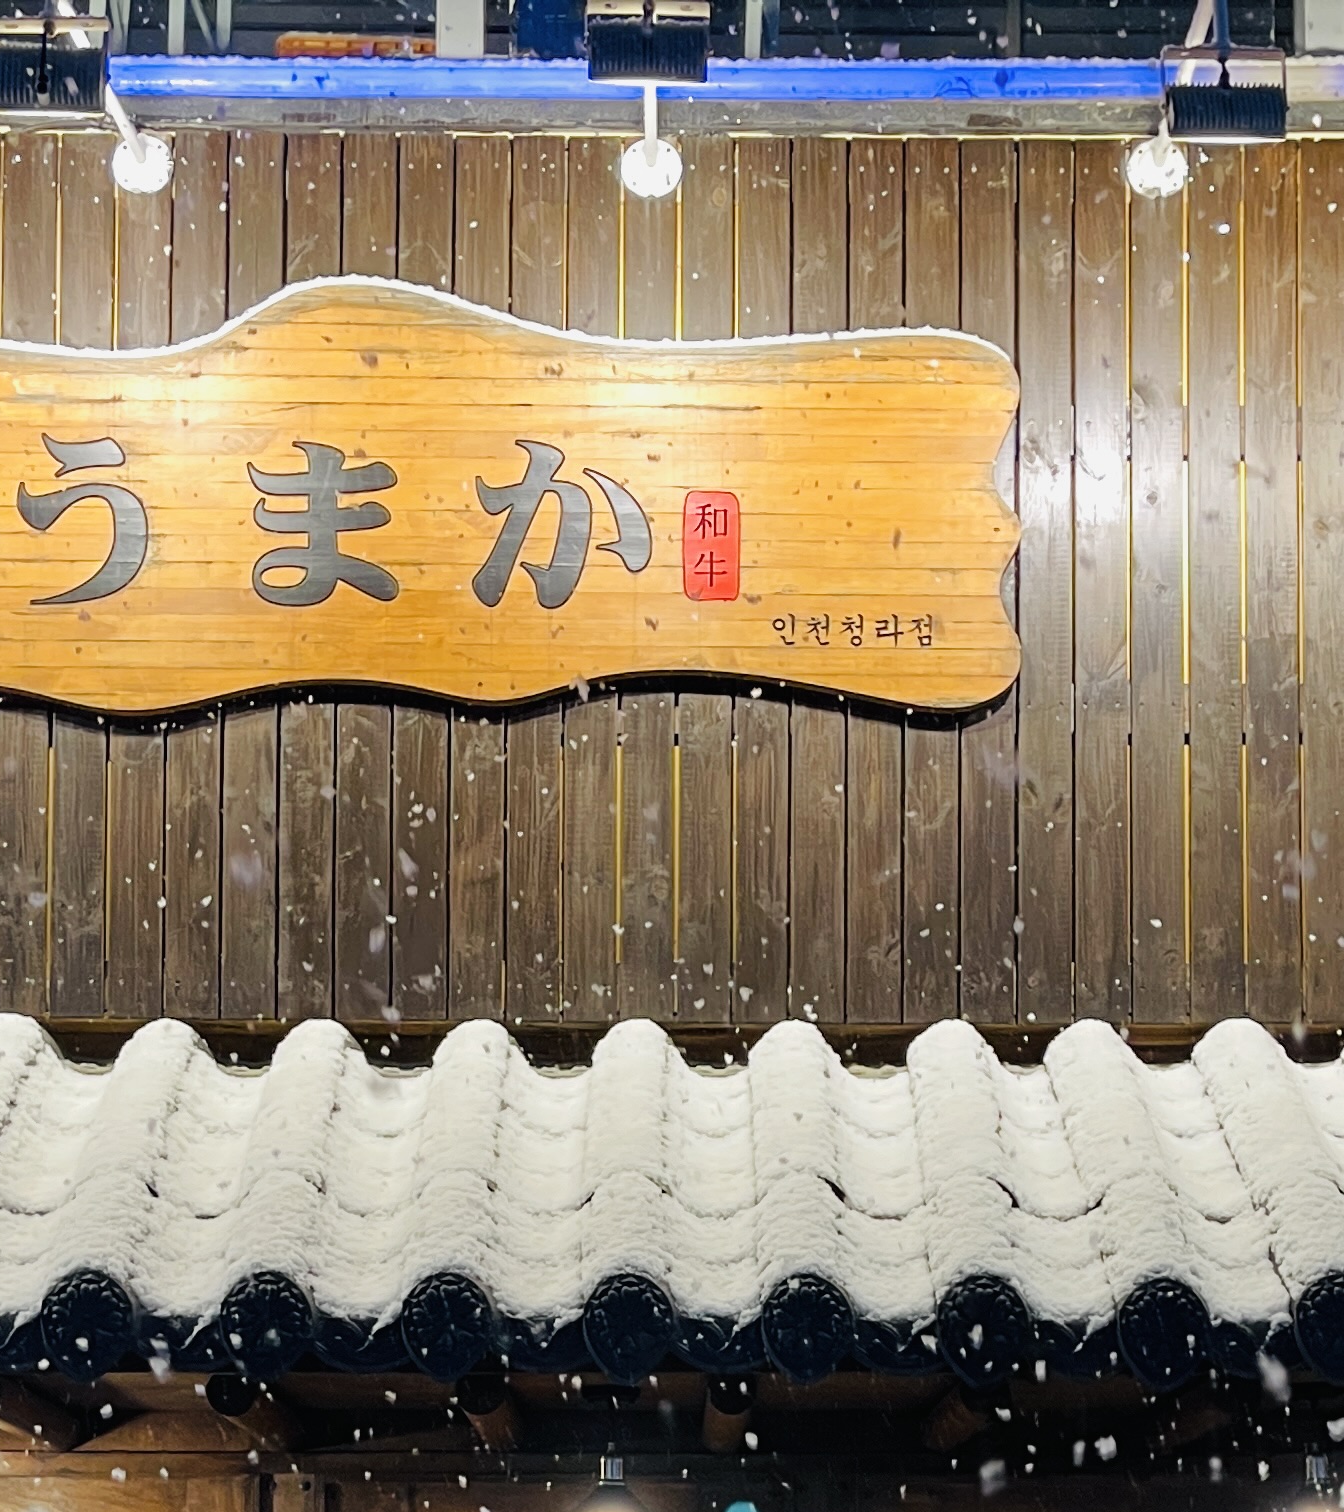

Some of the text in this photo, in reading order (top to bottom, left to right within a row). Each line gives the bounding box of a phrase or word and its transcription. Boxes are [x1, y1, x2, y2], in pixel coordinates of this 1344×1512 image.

[16, 431, 653, 610] うまか
[692, 503, 729, 588] 和牛
[772, 612, 935, 648] 인천청라점
